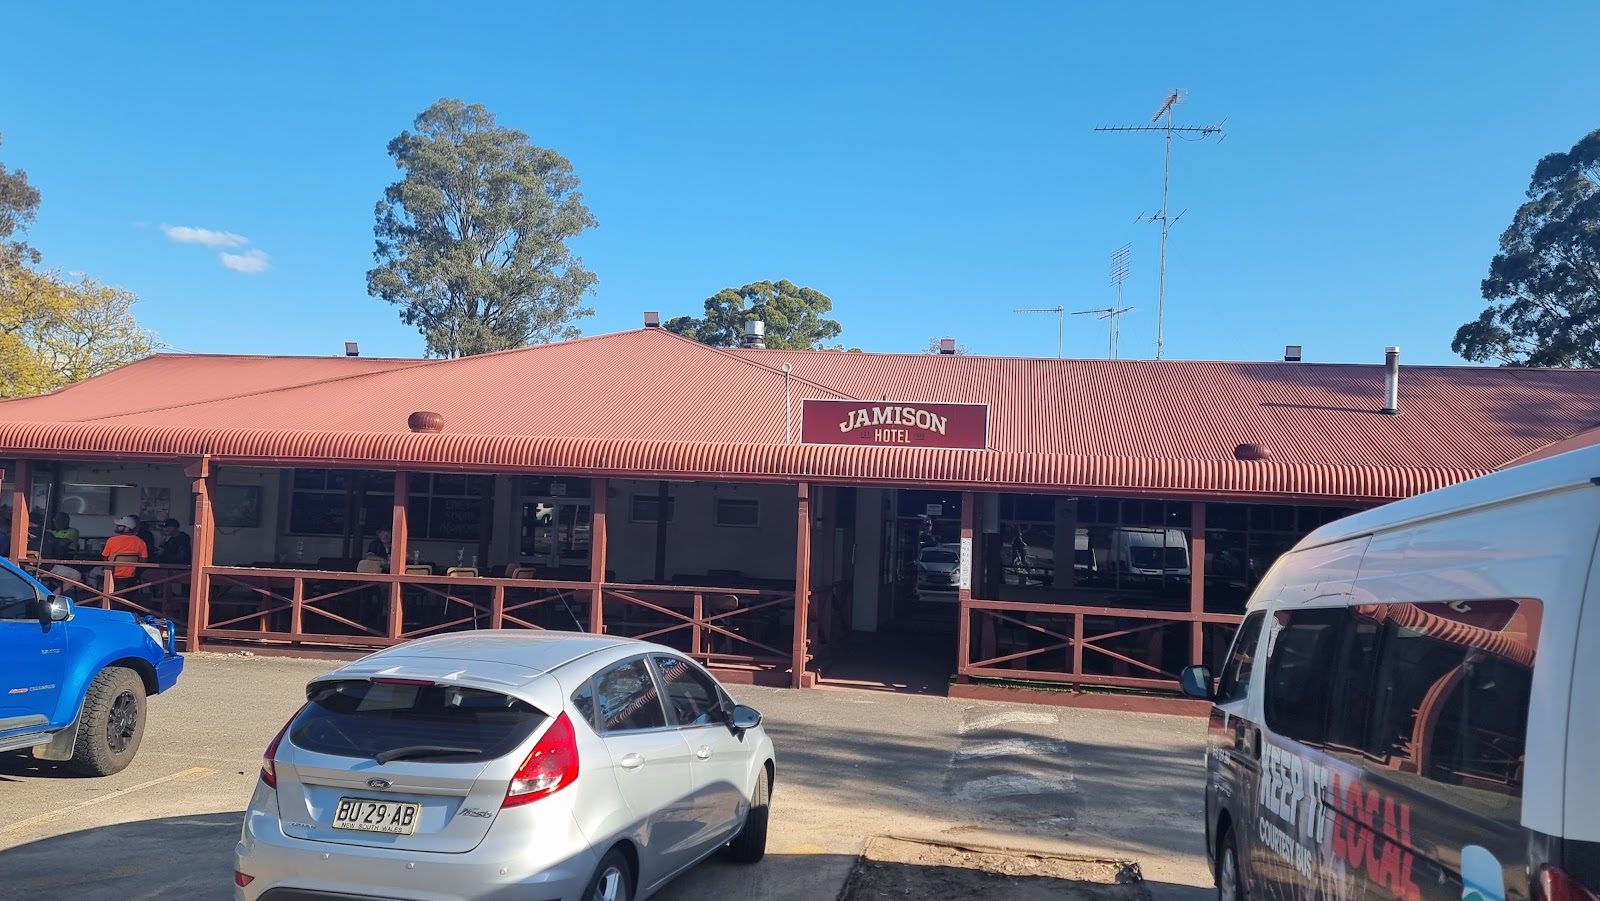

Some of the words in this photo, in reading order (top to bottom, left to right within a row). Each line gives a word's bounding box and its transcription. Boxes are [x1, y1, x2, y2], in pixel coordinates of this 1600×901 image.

[839, 406, 947, 435] JAMISON
[874, 428, 911, 443] HOTEL
[358, 823, 380, 831] SOUTH
[382, 825, 403, 833] WALES
[1259, 741, 1305, 826] KEEP
[1307, 761, 1329, 844] IT
[1331, 773, 1422, 901] LOCAL
[1259, 816, 1295, 868] COURTESY
[1294, 841, 1312, 881] BUS
